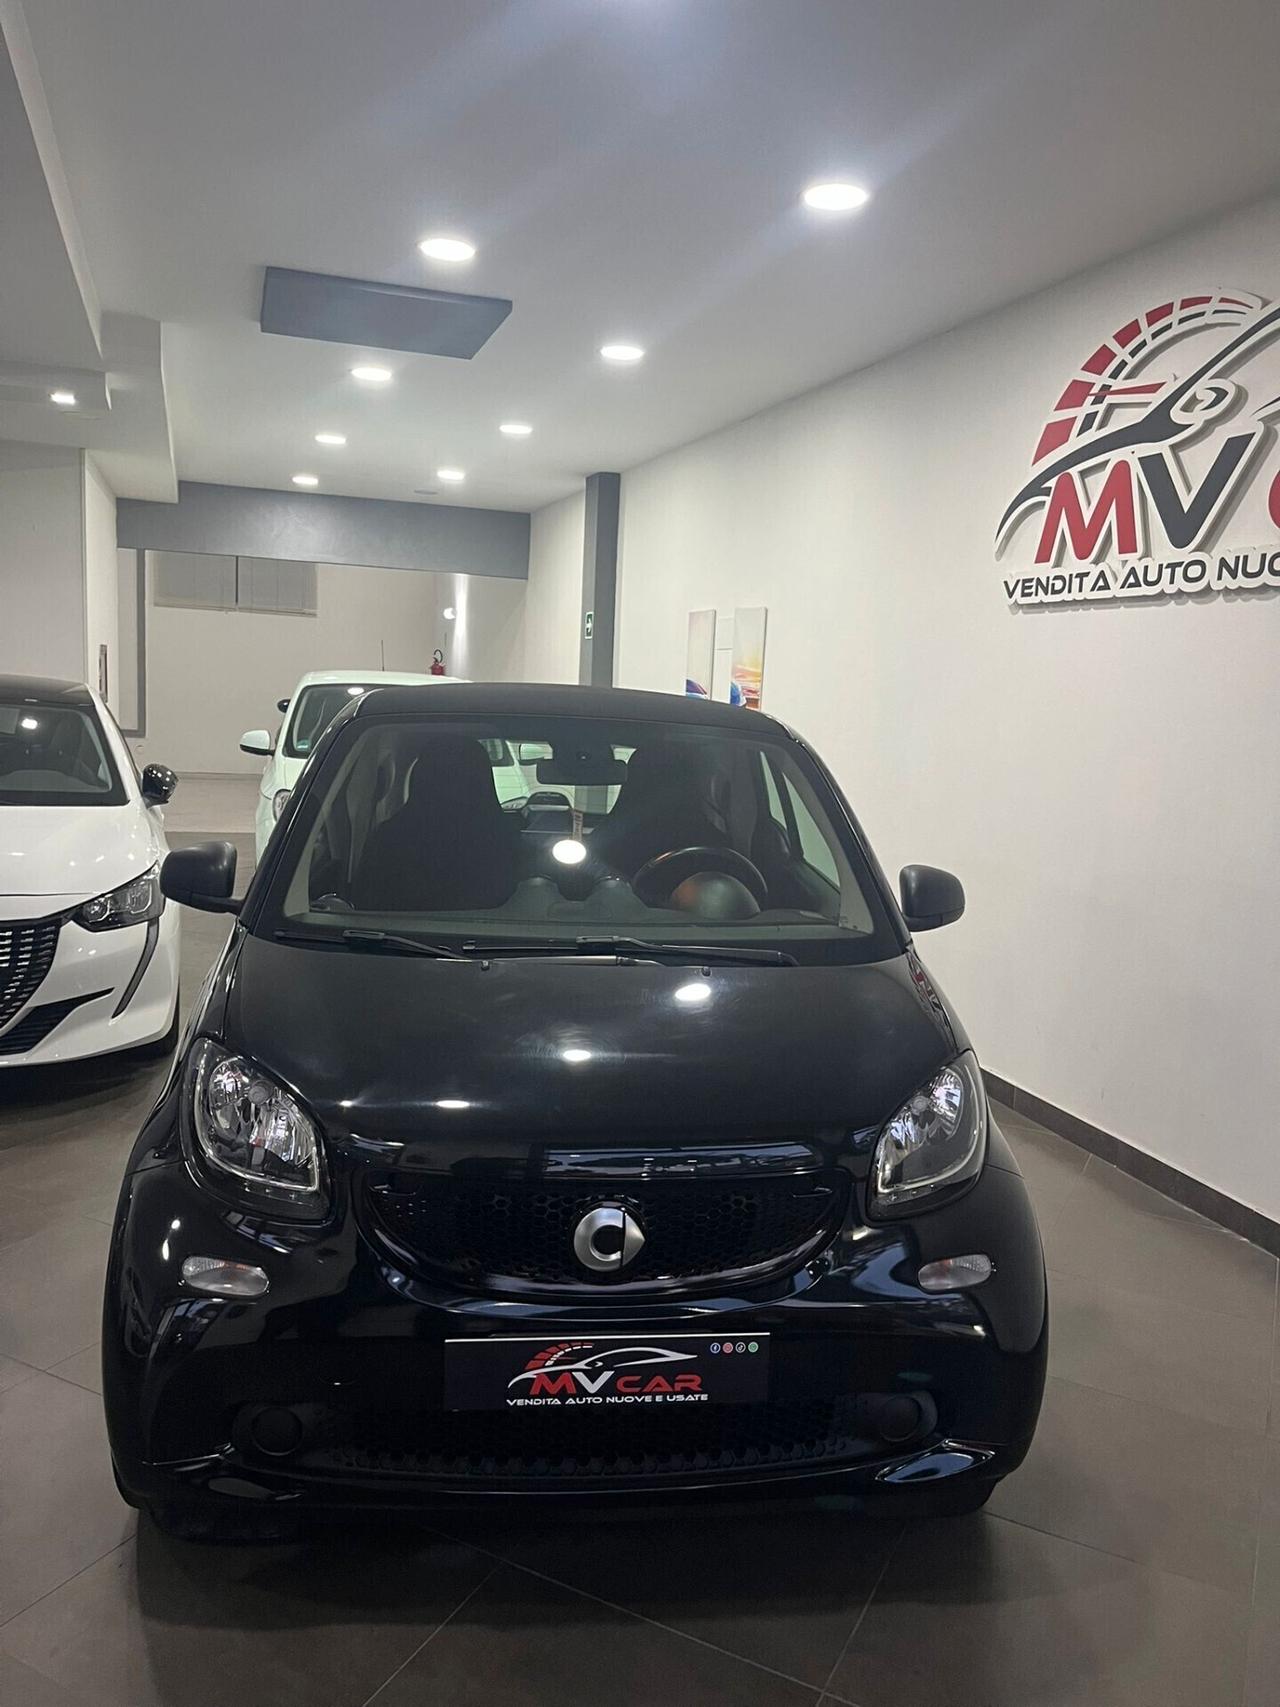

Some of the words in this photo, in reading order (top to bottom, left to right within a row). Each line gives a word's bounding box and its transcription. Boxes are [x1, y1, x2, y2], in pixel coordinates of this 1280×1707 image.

[1034, 432, 1257, 564] MV
[1003, 569, 1112, 599] VENDITA
[1119, 559, 1207, 590] AUTO
[529, 1371, 615, 1395] MV
[616, 1374, 703, 1393] CAR
[506, 1398, 562, 1406] VENDITA
[565, 1396, 603, 1405] AUTO
[606, 1395, 652, 1404] NUOVE
[655, 1394, 663, 1403] E
[666, 1393, 709, 1402] USATE
